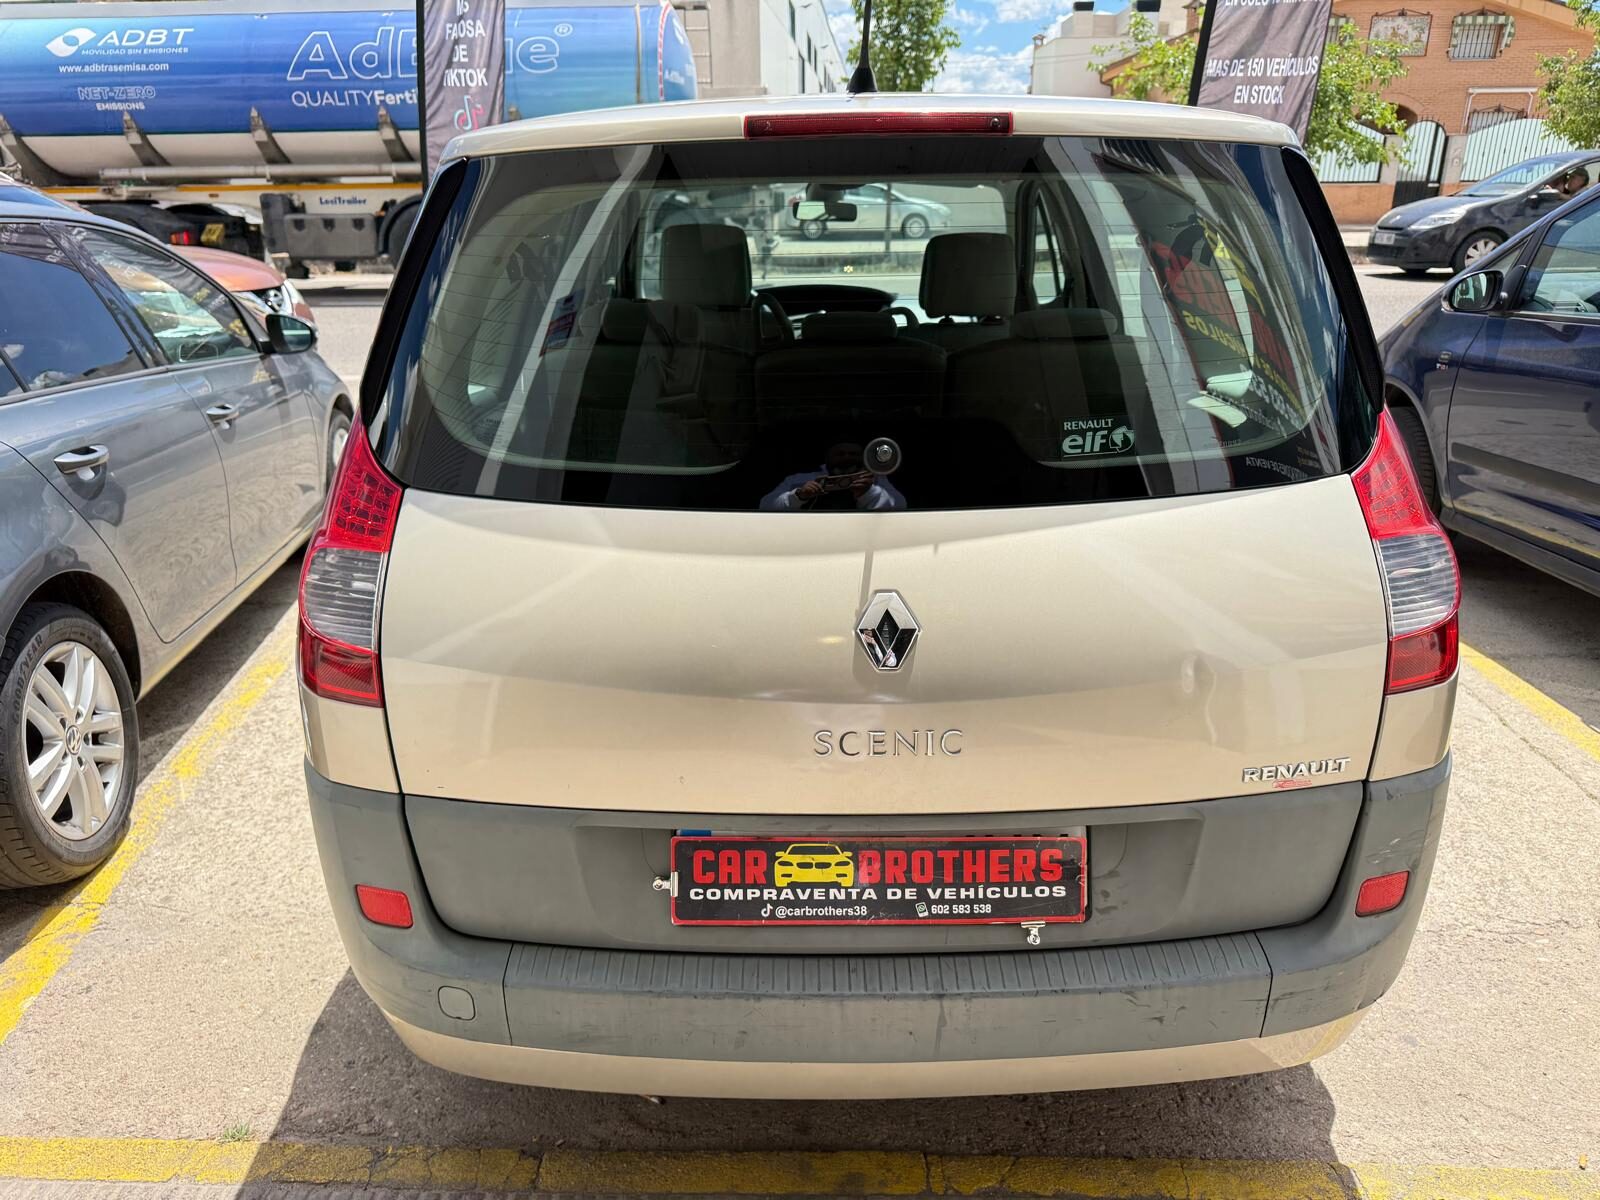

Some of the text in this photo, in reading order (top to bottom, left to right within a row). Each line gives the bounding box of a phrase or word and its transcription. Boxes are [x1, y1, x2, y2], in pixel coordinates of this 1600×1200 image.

[97, 28, 195, 46] ADBT
[81, 48, 126, 56] MOVILIDAD
[59, 62, 169, 73] www.adbtrasemisa.com
[1229, 59, 1246, 77] DE
[1247, 58, 1265, 77] 150
[1266, 53, 1319, 77] VEHÍCULOS
[77, 86, 156, 100] NET-ZERO
[1233, 85, 1286, 105] EN STOCK
[1063, 418, 1113, 430] RENAULT
[1062, 430, 1108, 454] elf
[814, 729, 963, 757] SCENIC
[1242, 757, 1351, 783] RENAULT
[693, 848, 1063, 885] CAR BROTHERS
[689, 884, 1067, 900] COMPRAVENTA DE VEHÍCULOS
[775, 905, 867, 918] @carbrothers38
[931, 903, 992, 914] 602 583 538
